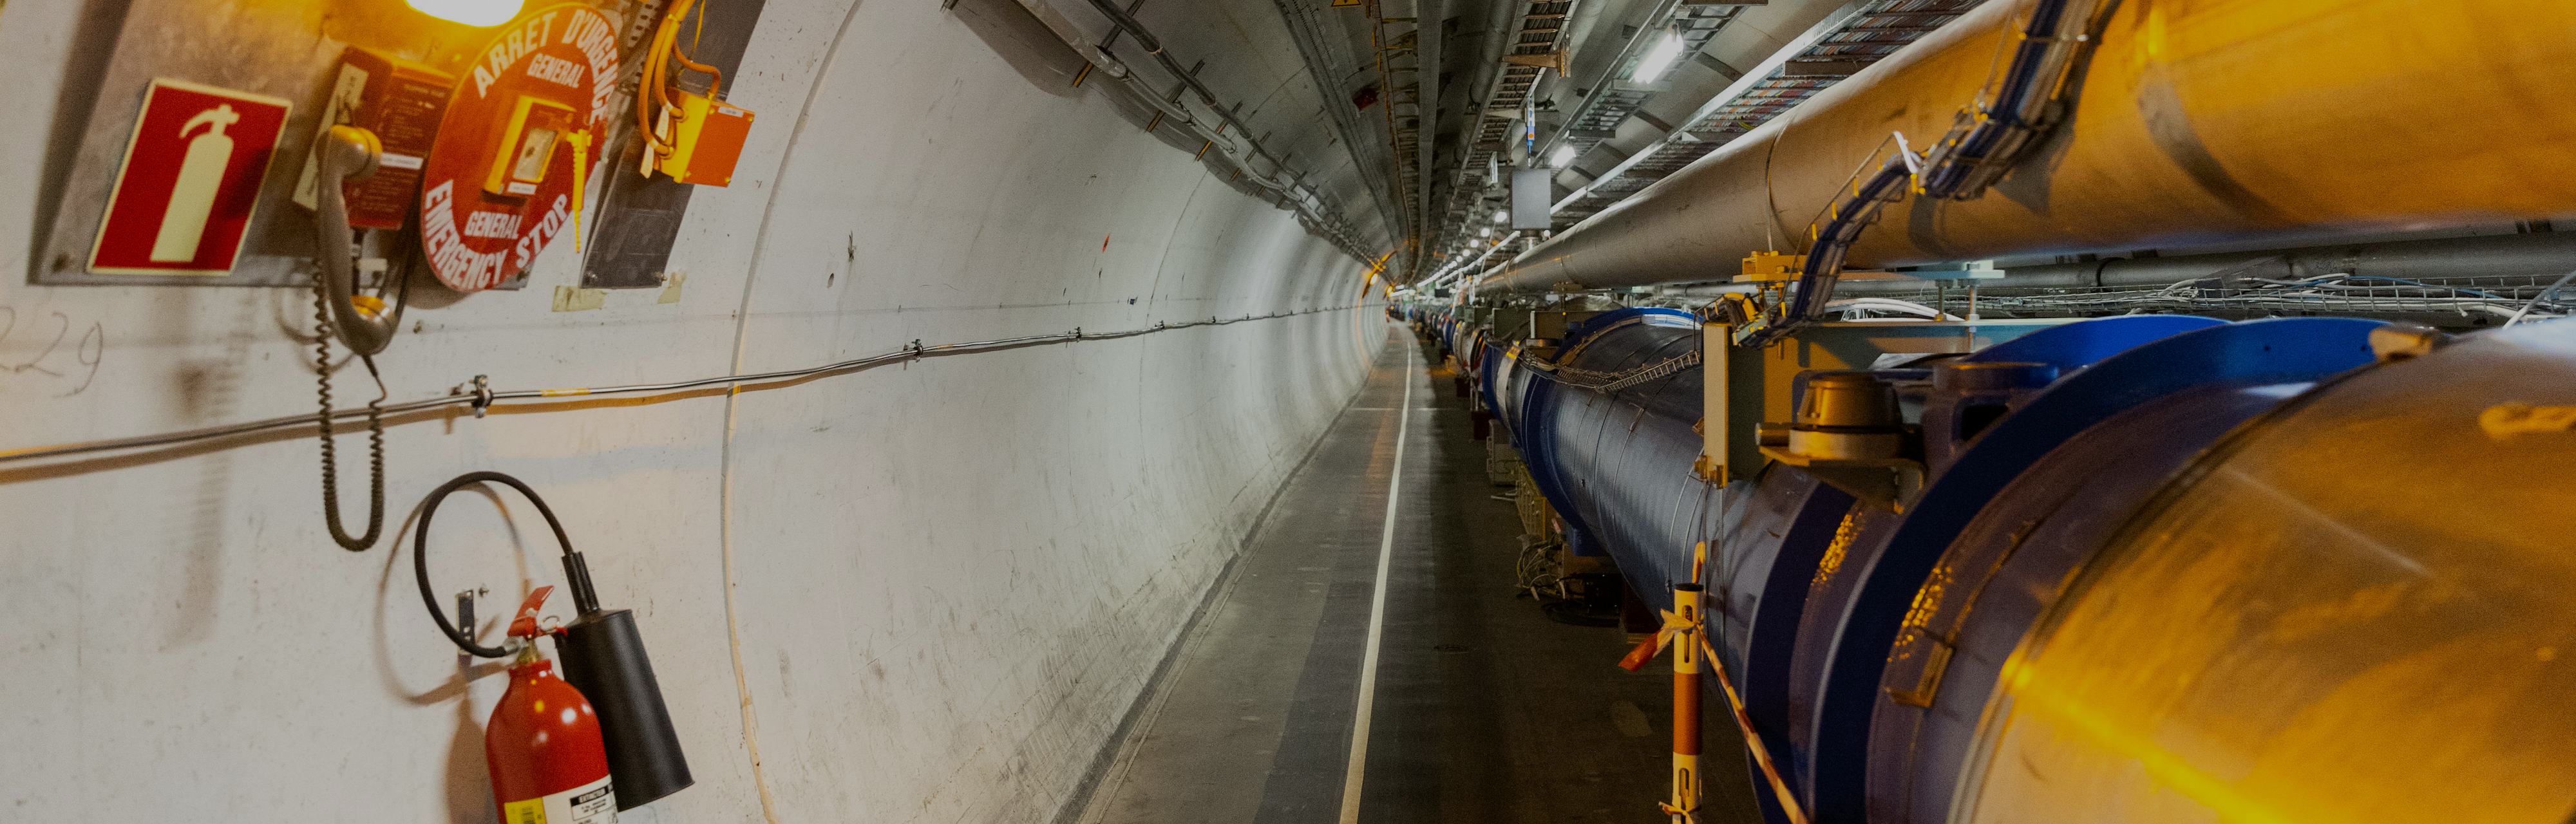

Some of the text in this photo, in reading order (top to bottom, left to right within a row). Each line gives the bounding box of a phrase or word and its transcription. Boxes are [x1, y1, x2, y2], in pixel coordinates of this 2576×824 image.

[474, 9, 618, 124] ARRET D'URGENCE
[527, 53, 585, 88] GENERAL
[425, 180, 567, 289] EMERGENCY STOP
[464, 211, 522, 239] GENERAL
